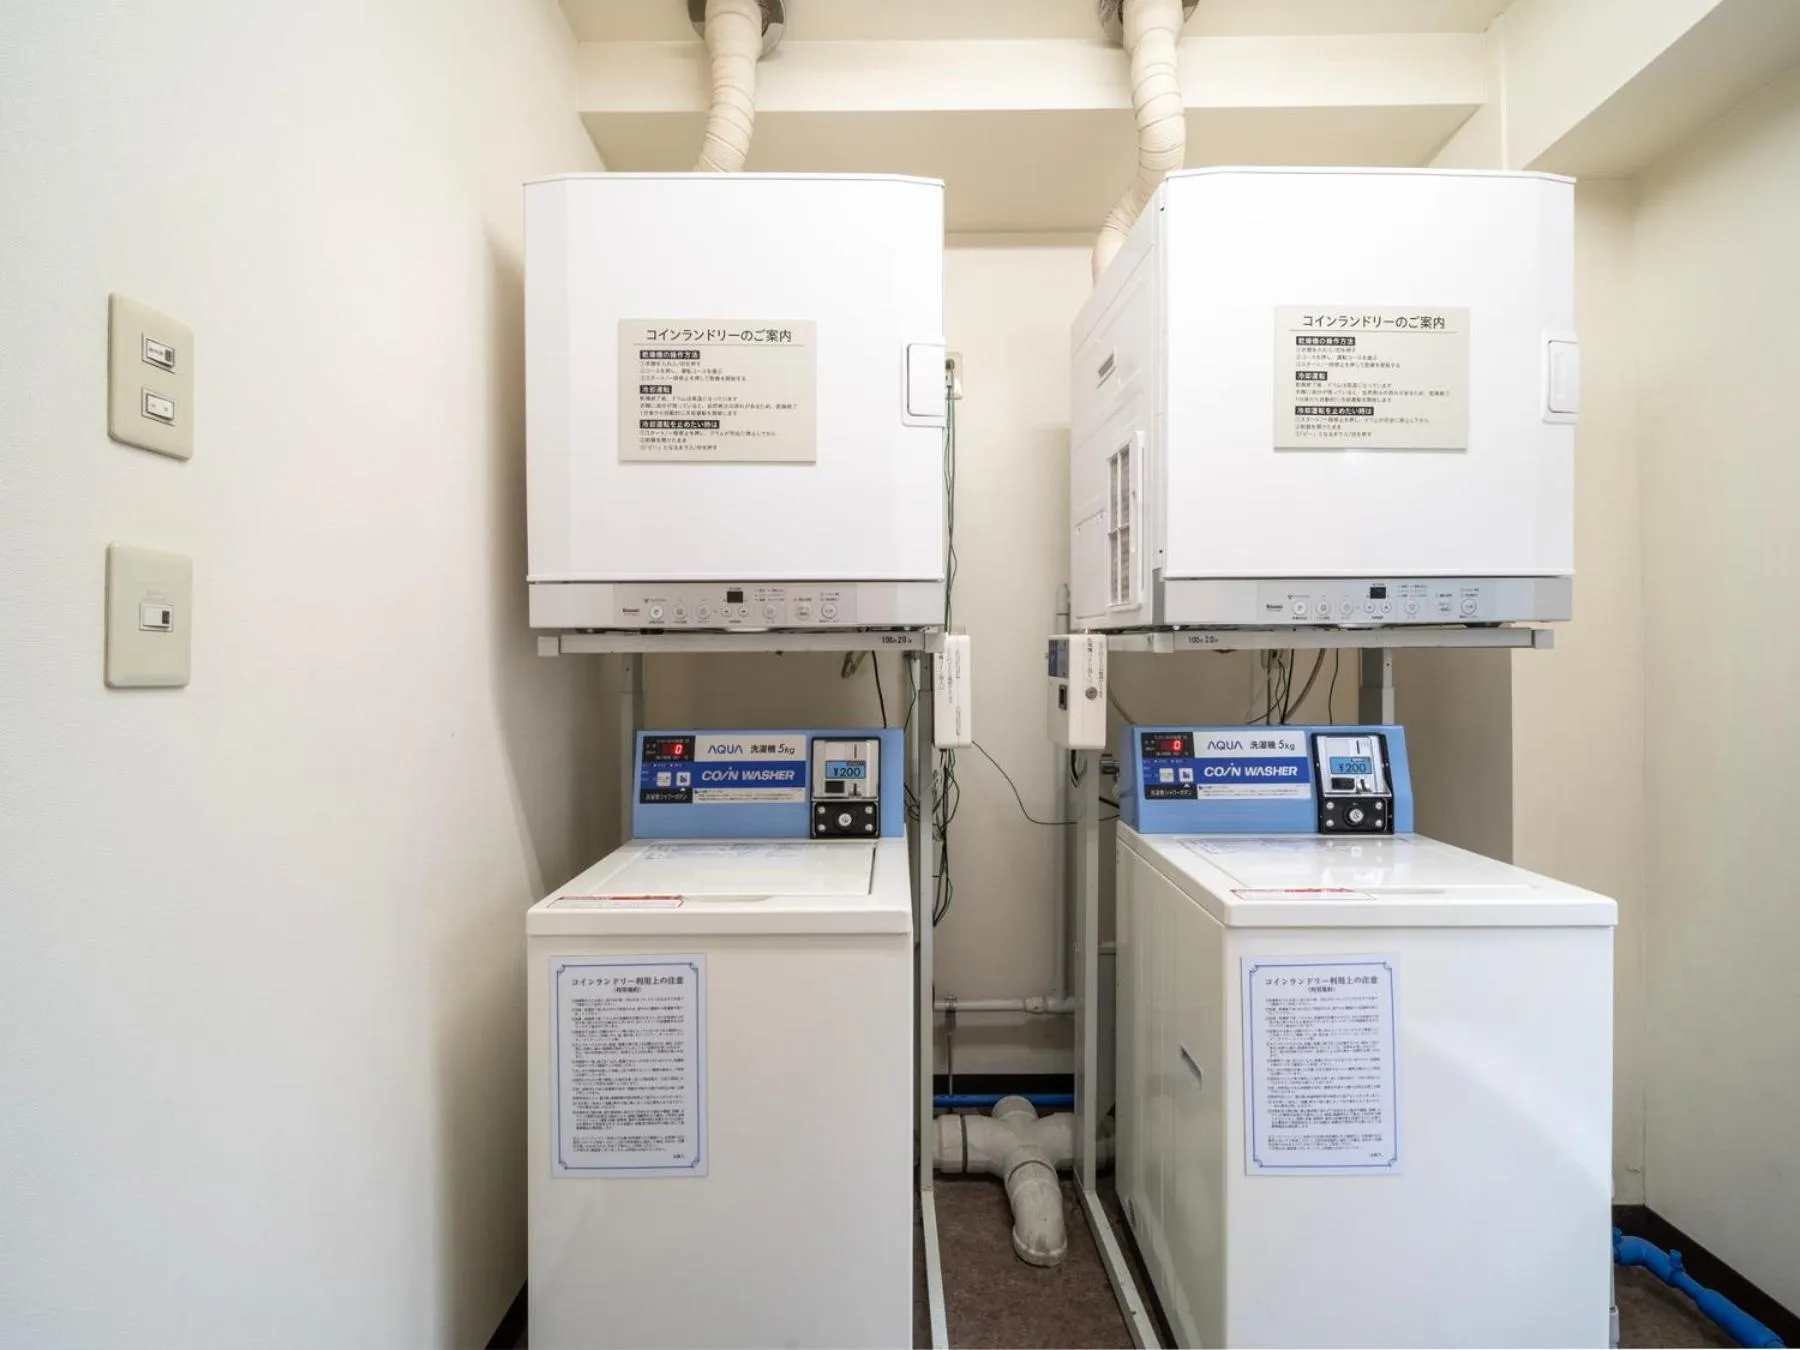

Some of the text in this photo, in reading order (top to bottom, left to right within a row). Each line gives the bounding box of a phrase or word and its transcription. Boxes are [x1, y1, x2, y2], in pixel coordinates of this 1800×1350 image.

[1303, 315, 1445, 329] コインランドリーのご案内
[646, 328, 792, 342] コインランドリーのご案内
[708, 743, 796, 755] AQUA 洗濯機 5kg
[1207, 739, 1296, 751] AQUA 洗濯機 5kg
[741, 769, 795, 781] WASHER
[833, 767, 862, 778] ¥200
[1244, 766, 1298, 777] WASHER
[571, 976, 684, 986] コインランドリー利用上の注意
[1264, 976, 1378, 987] コインランドリー利用上の注意
